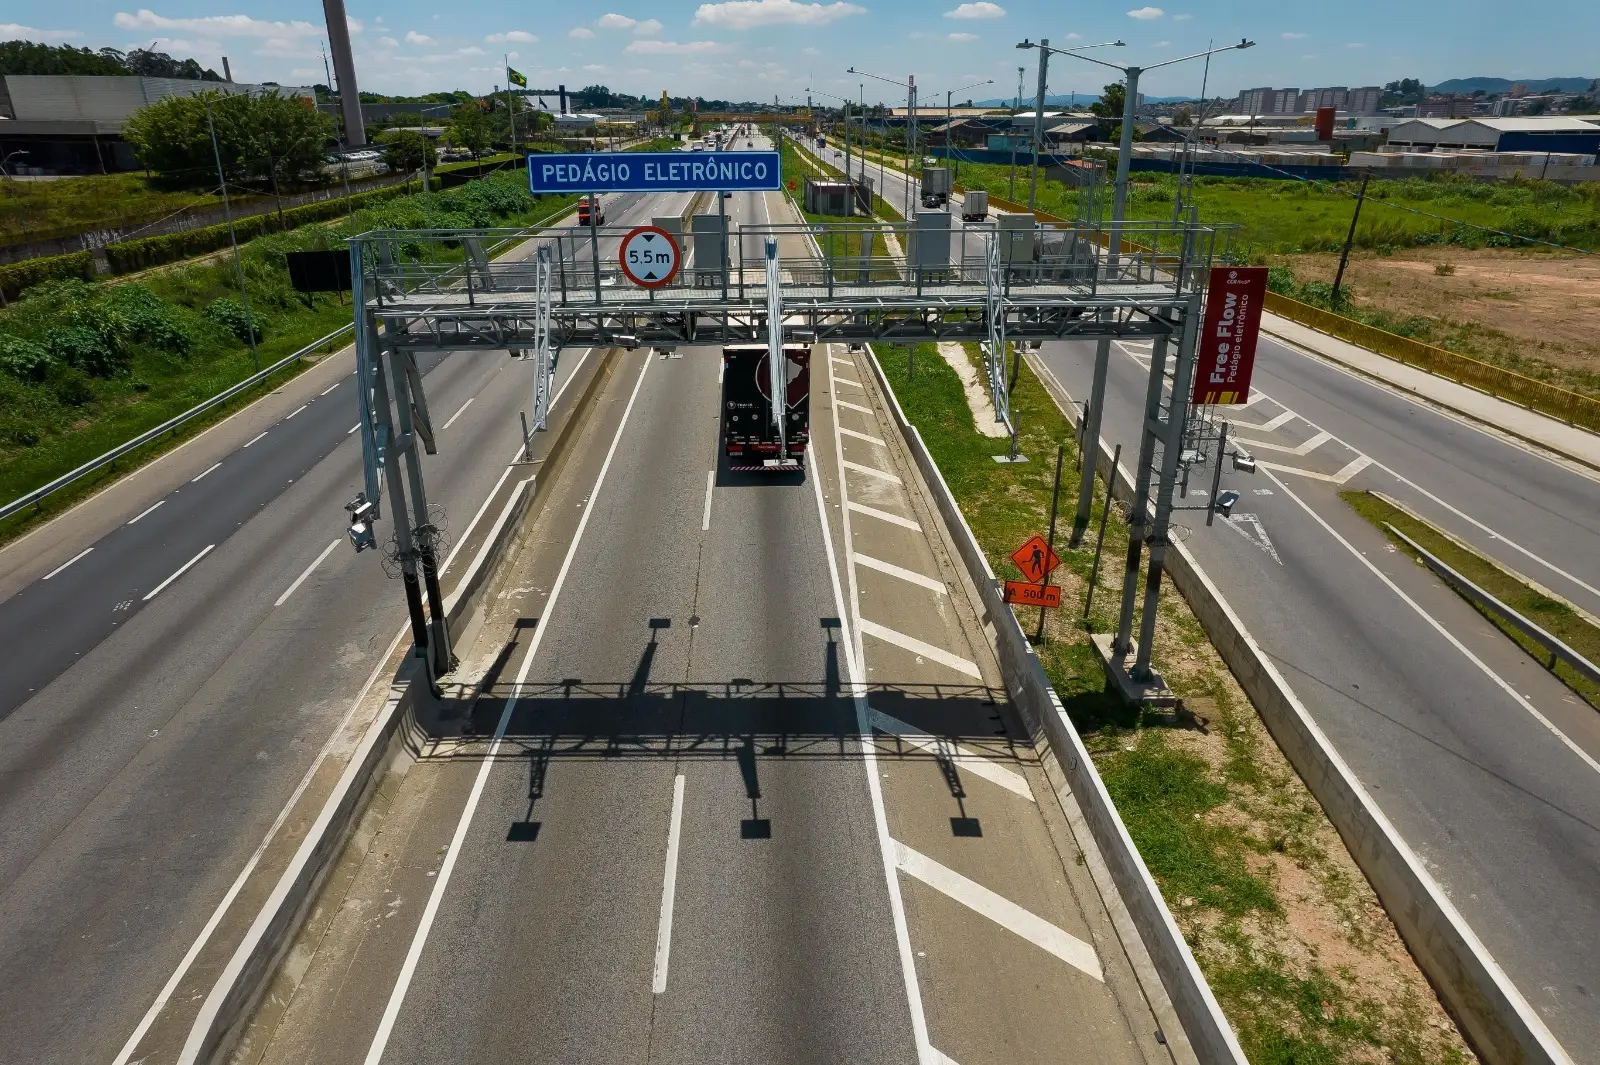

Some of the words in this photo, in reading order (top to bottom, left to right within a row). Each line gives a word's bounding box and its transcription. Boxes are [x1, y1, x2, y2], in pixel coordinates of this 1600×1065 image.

[543, 158, 630, 182] PEDÁGIO
[644, 157, 767, 181] ELETRÔNICO
[1217, 292, 1237, 338] Flow
[1227, 345, 1241, 383] Pedágio
[1234, 294, 1249, 343] eletrônico
[1210, 342, 1230, 383] Free
[1024, 589, 1042, 598] 500
[1046, 593, 1056, 601] m
